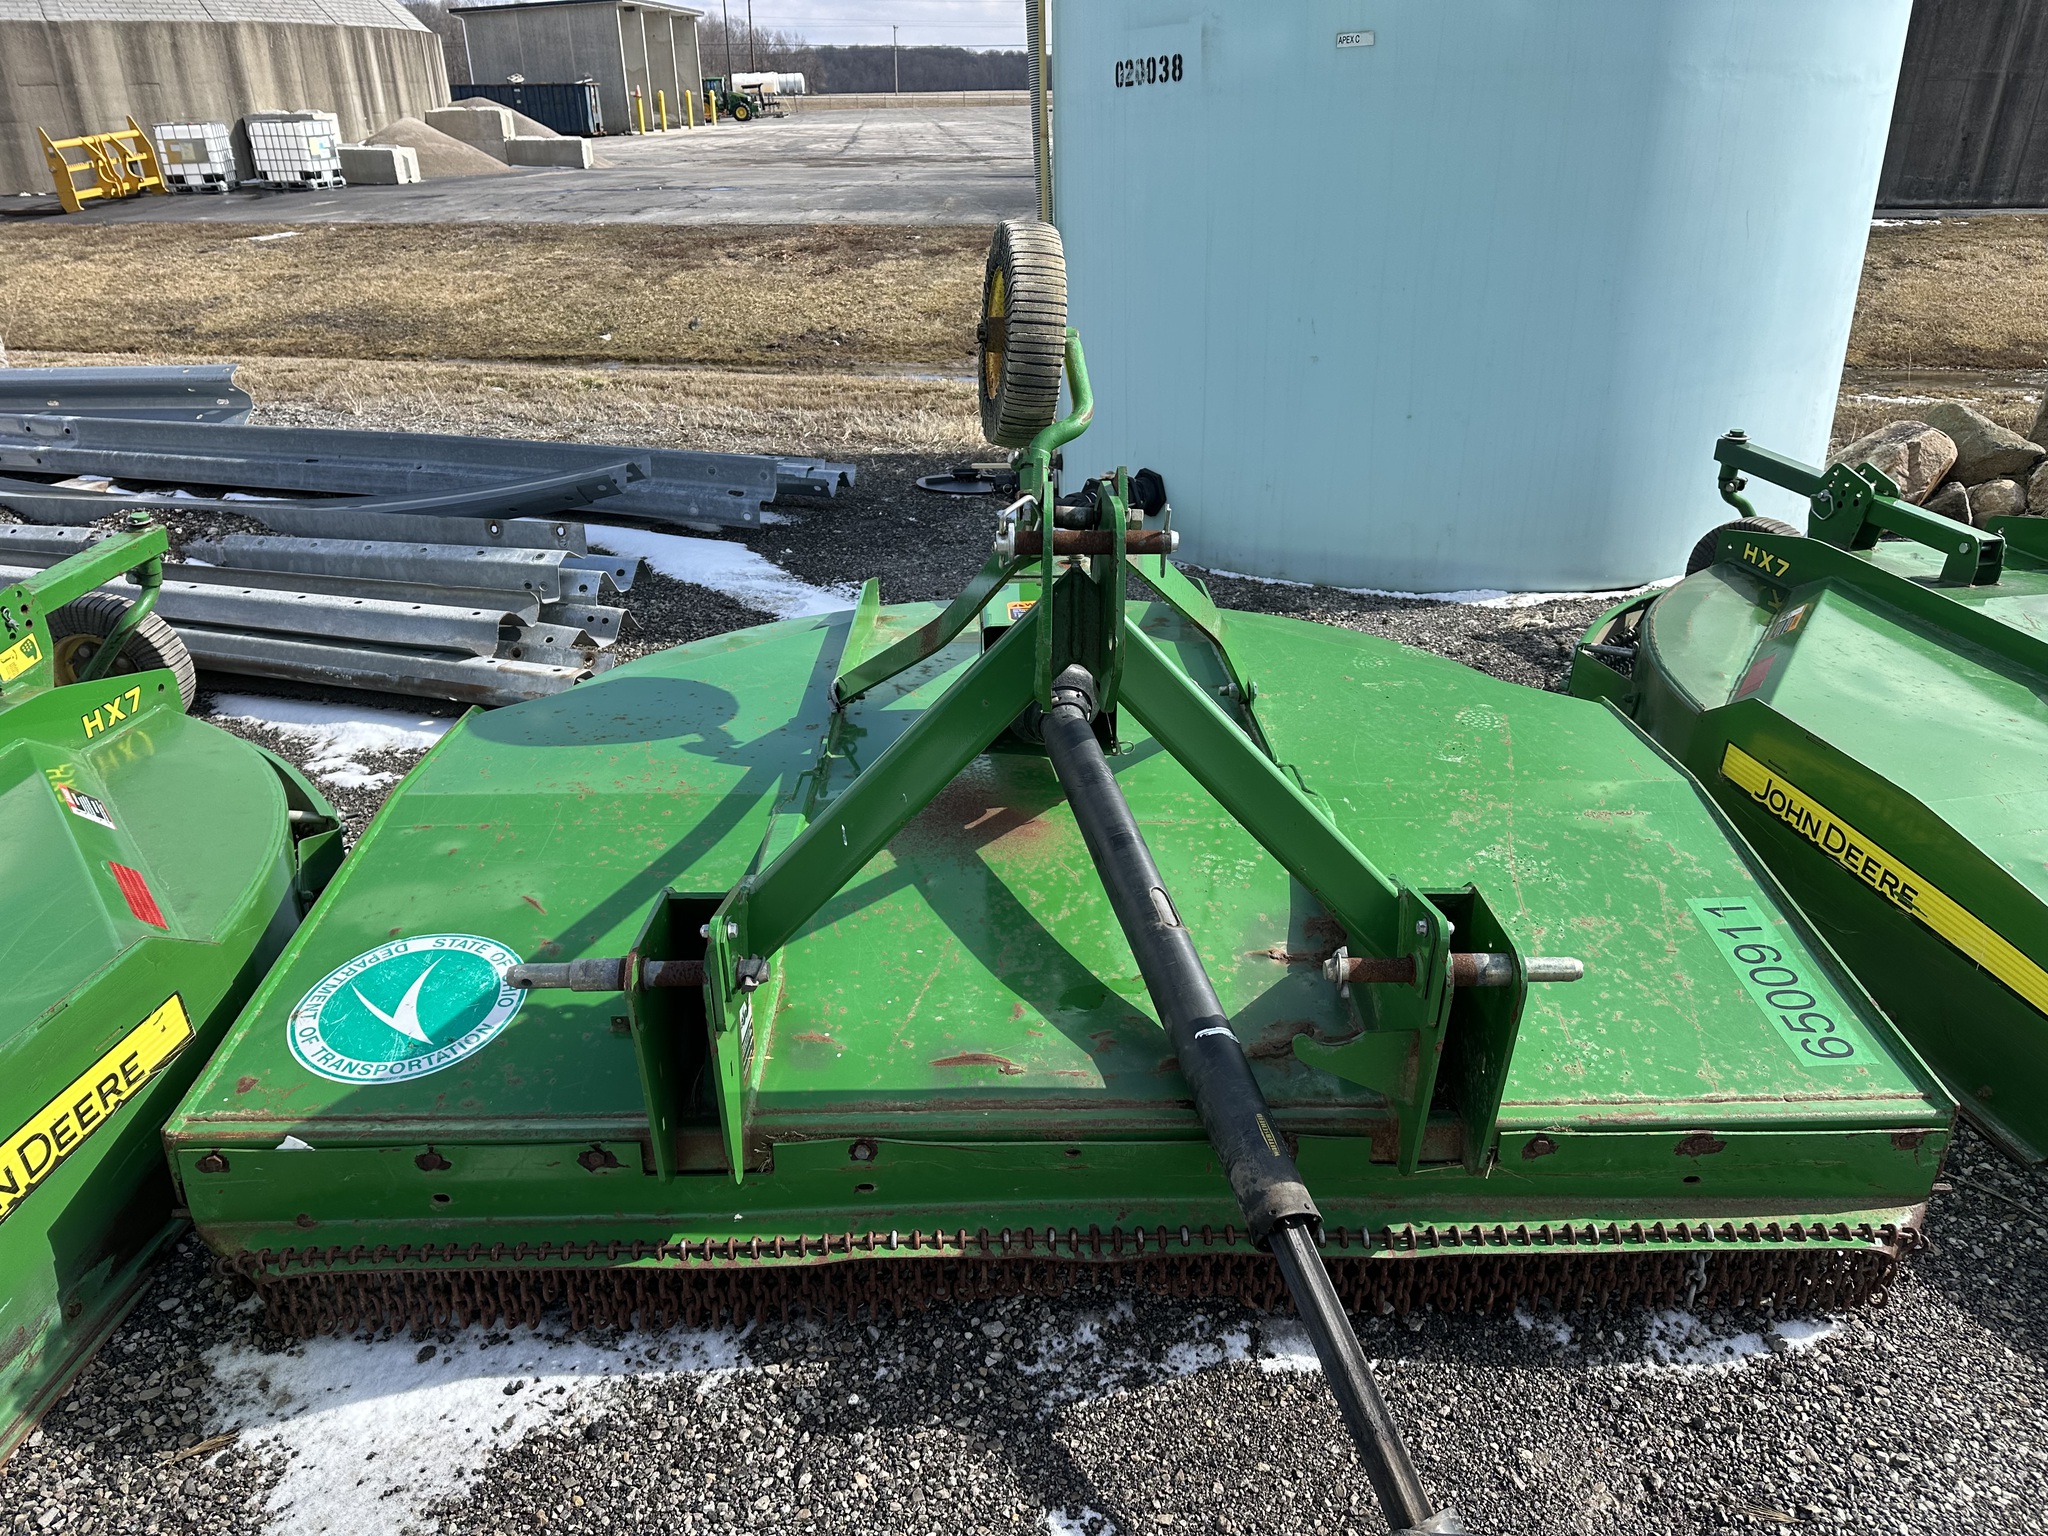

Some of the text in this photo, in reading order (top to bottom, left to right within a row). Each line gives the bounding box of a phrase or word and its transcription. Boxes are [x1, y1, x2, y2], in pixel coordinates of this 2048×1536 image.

[1337, 34, 1360, 45] APEX C
[1743, 542, 1791, 577] HX7
[80, 684, 141, 739] HX7
[1753, 778, 1919, 911] JOHN DEERE
[299, 943, 495, 1076] DEPARTMENT OF TRANSPORTATION
[432, 938, 518, 1008] STATE OF HIO
[1702, 906, 1855, 1059] 6500911
[17, 1050, 146, 1180] DEERE
